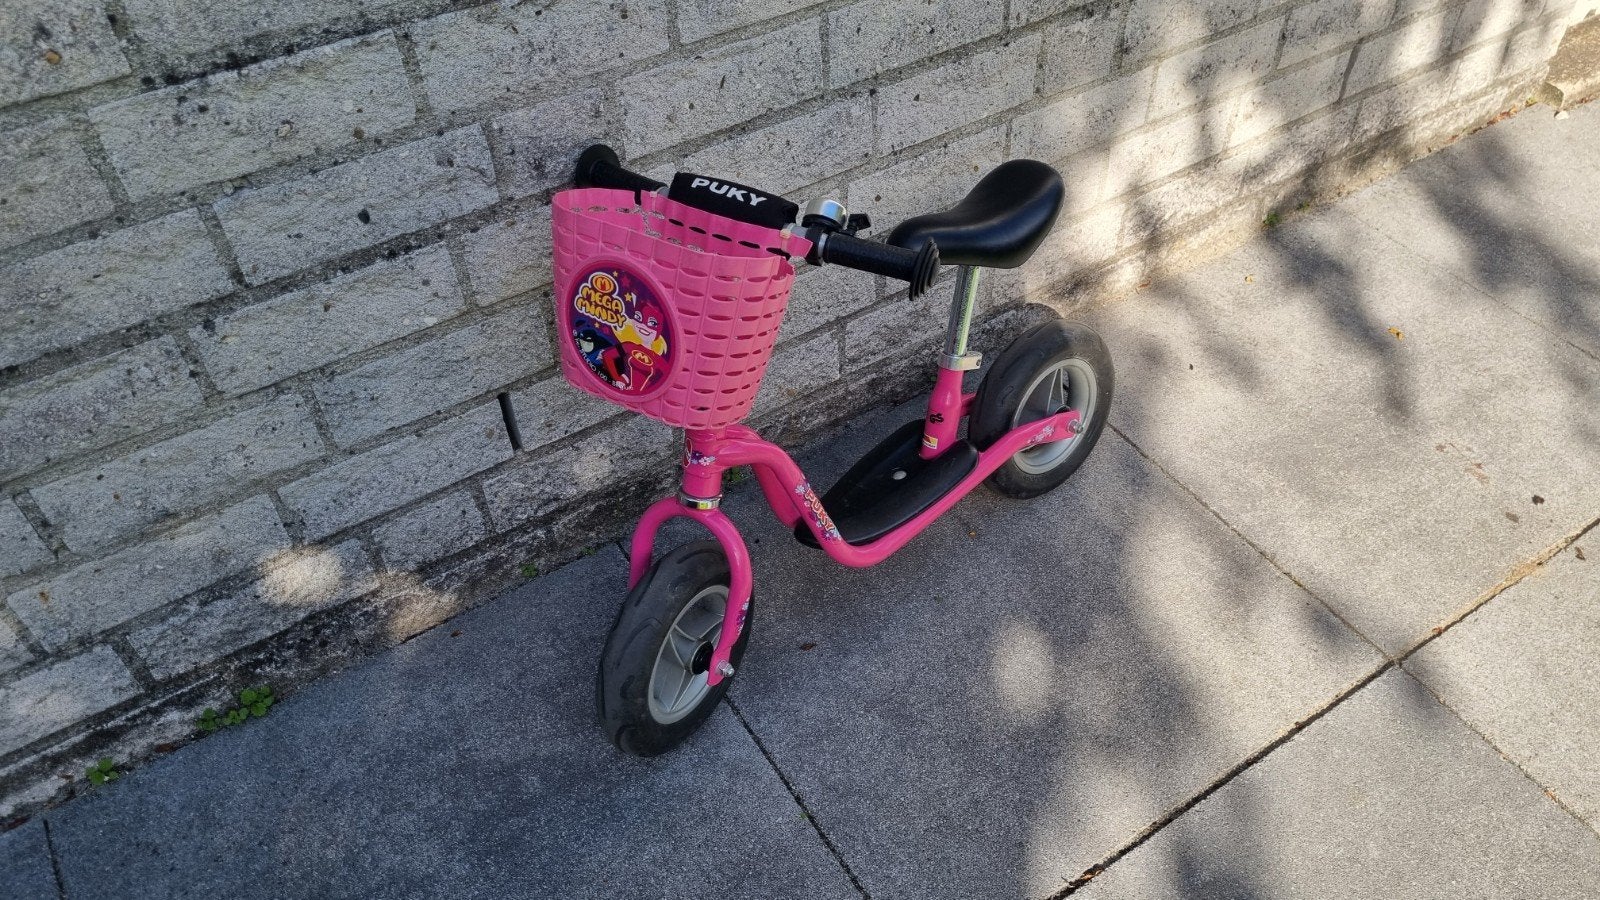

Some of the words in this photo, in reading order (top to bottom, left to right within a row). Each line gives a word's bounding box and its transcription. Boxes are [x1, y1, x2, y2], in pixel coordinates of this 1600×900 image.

[691, 177, 767, 206] PUKY
[581, 286, 623, 313] MEGA
[804, 488, 836, 532] PUKY
